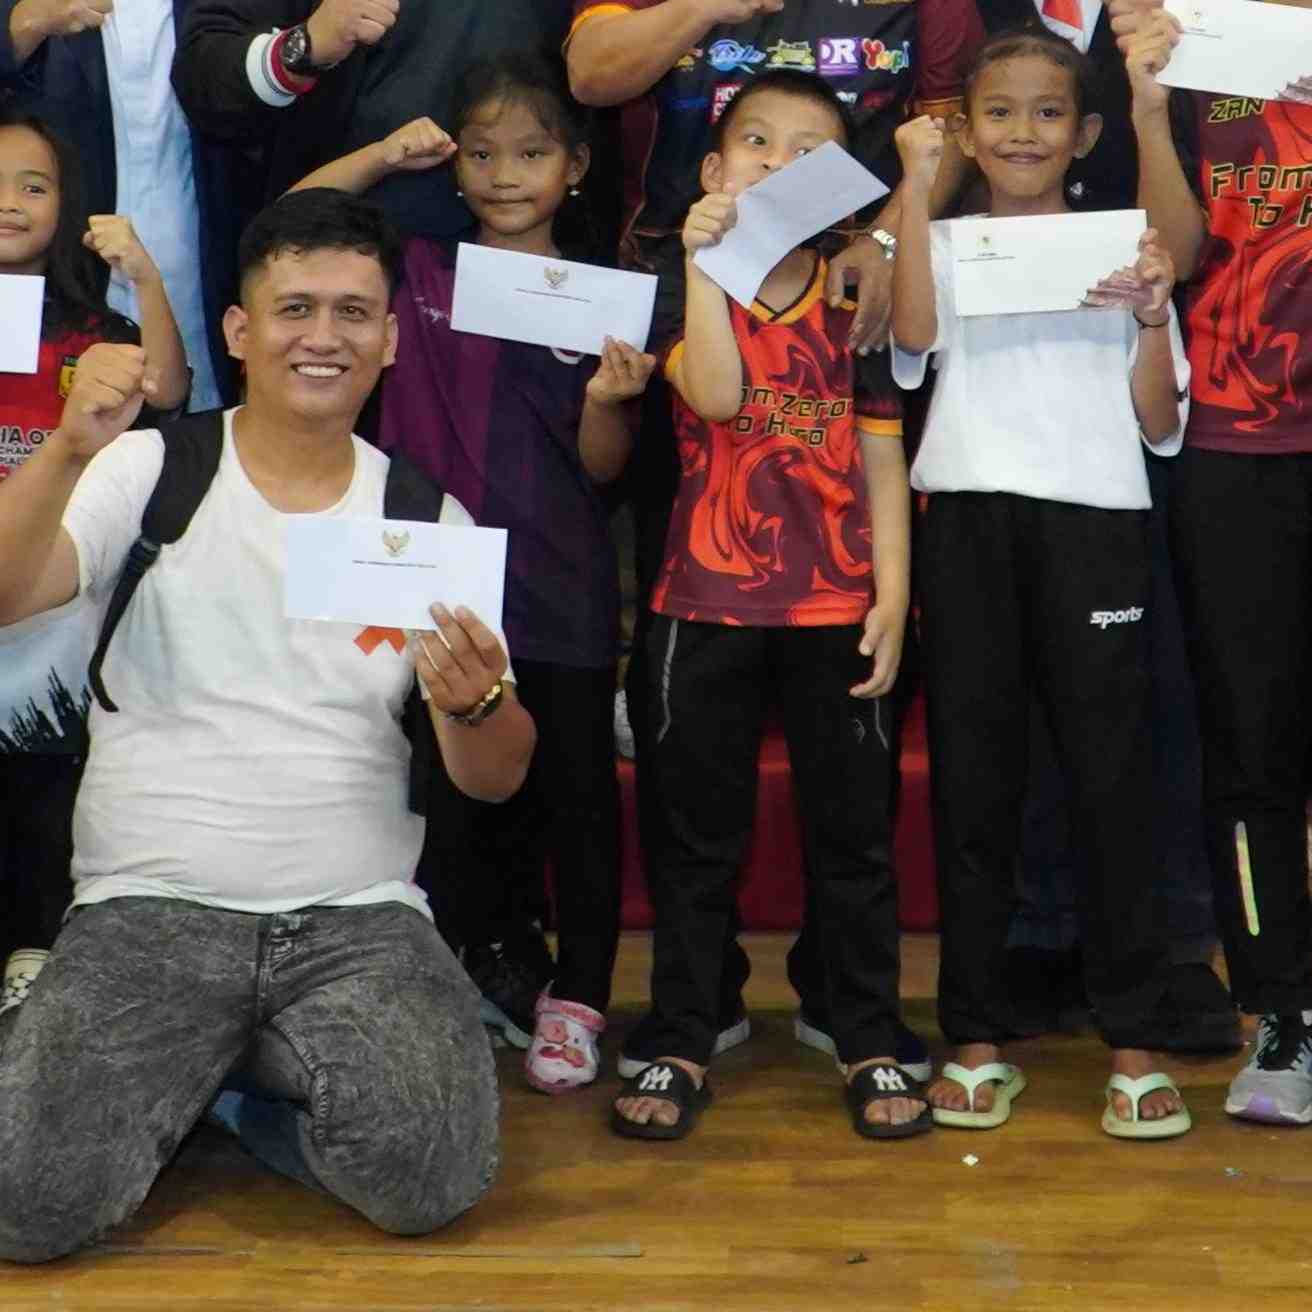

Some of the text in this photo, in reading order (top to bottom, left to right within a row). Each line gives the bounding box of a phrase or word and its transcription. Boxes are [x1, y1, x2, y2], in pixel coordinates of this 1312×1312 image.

[863, 38, 910, 73] Yupi
[1248, 195, 1285, 229] To
[779, 392, 851, 419] Zero
[1089, 606, 1145, 630] sports
